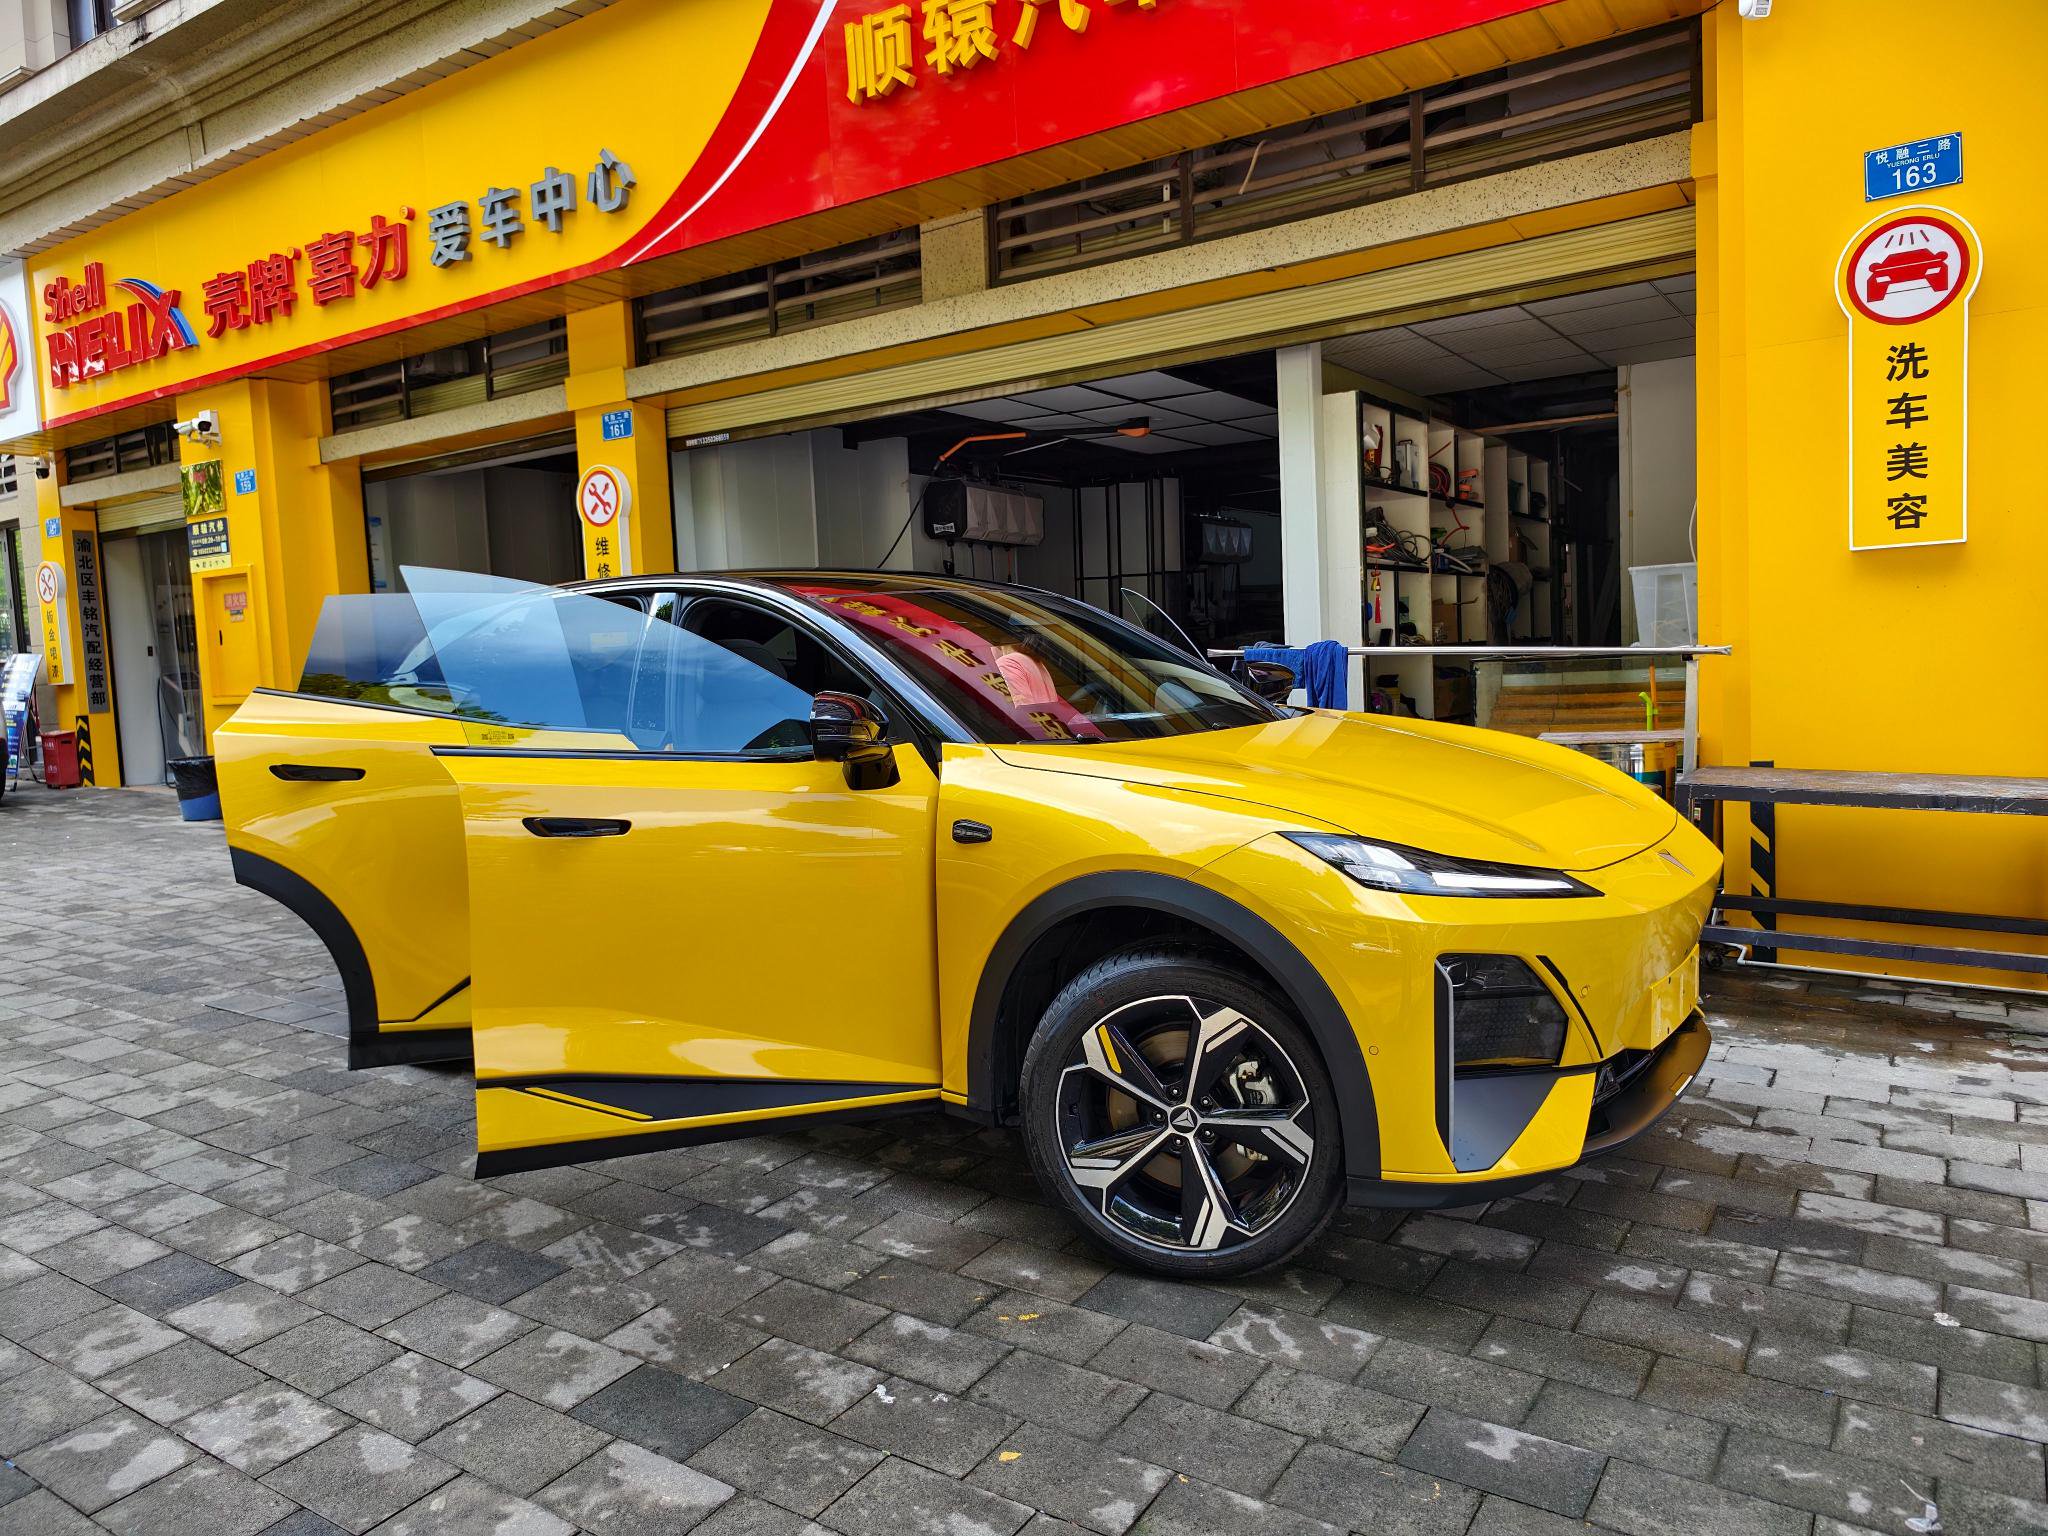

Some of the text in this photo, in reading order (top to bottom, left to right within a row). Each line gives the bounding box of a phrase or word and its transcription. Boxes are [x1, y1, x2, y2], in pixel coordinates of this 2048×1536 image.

[1876, 138, 1951, 165] 悦融二路
[1887, 153, 1940, 168] YUERONG ERLU
[1892, 162, 1937, 190] 163
[429, 148, 637, 268] 爱车中心
[44, 262, 106, 323] Shell
[46, 285, 190, 389] HELIX
[610, 423, 625, 437] 161
[1886, 342, 1929, 530] 洗车美容
[76, 538, 106, 705] 渝北区丰铭汽配经营部
